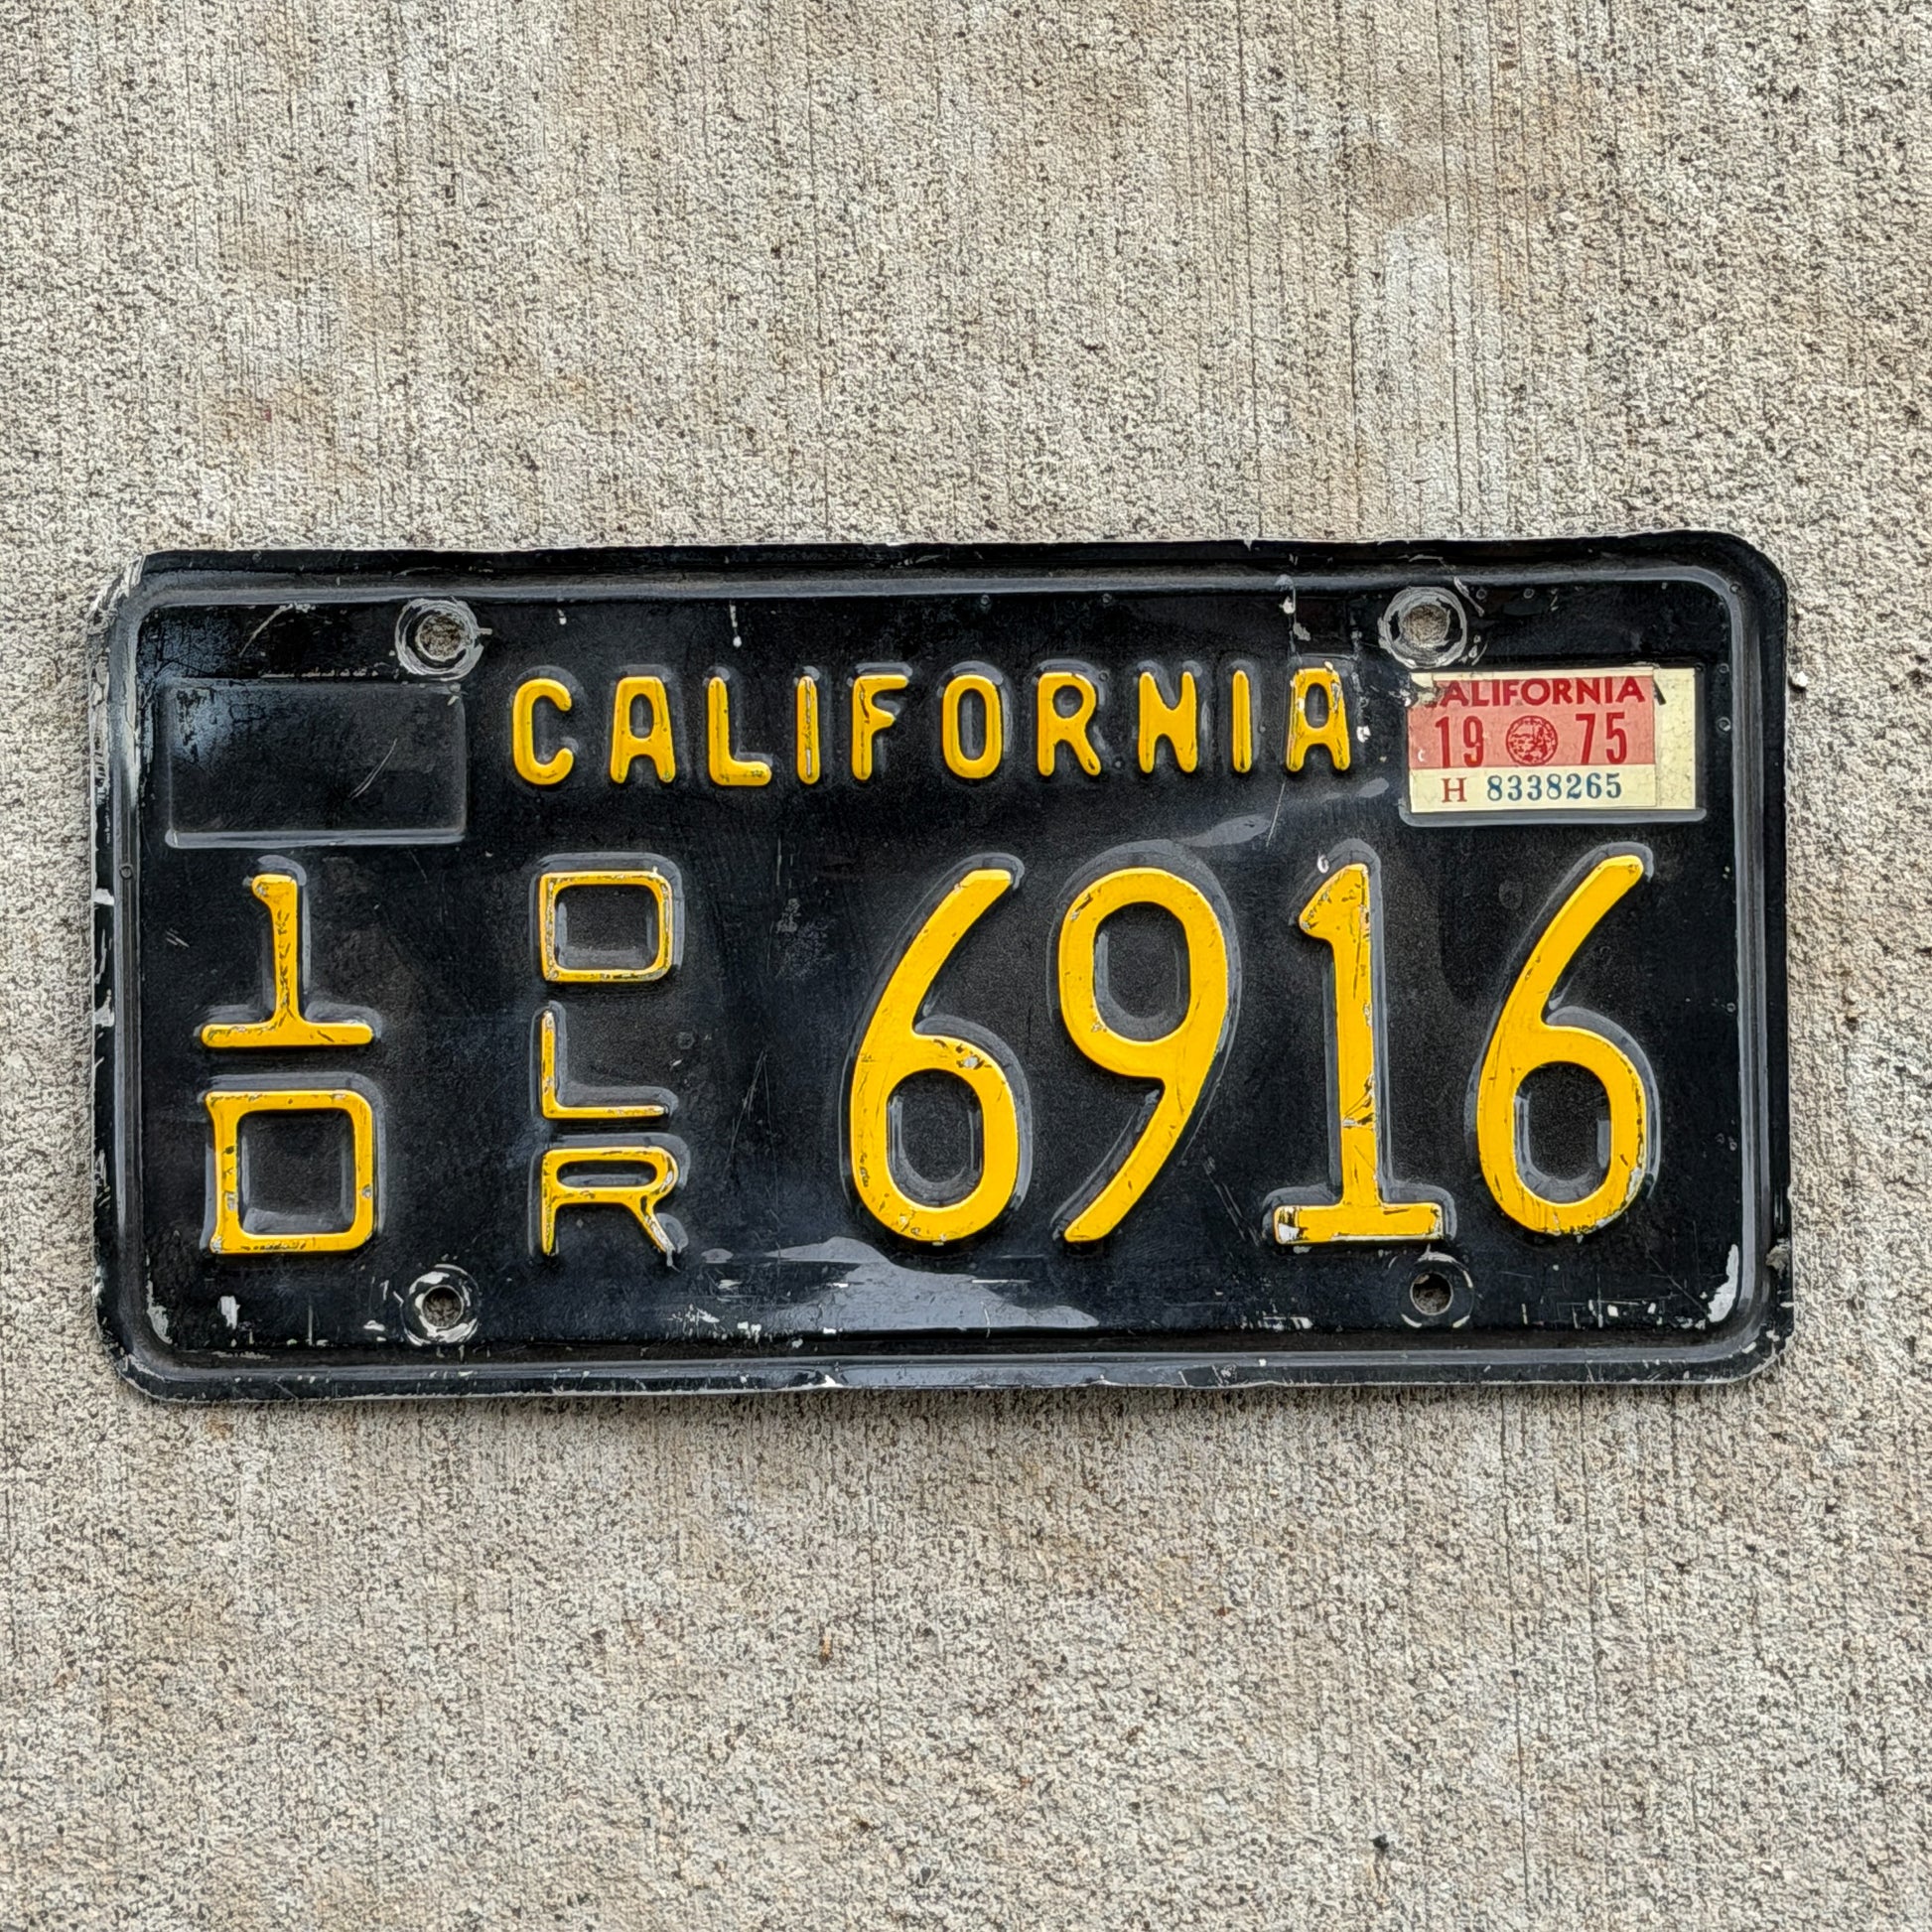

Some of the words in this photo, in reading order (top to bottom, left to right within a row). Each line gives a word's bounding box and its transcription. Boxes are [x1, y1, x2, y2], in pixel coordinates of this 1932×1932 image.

[1425, 676, 1646, 708] ALIFORNIA
[511, 667, 1353, 786] CALIFORNIA
[1435, 715, 1485, 768] 19
[1575, 711, 1628, 766] 75
[1441, 776, 1467, 803] H
[1486, 771, 1623, 802] 8338265
[849, 857, 1648, 1245] 6916
